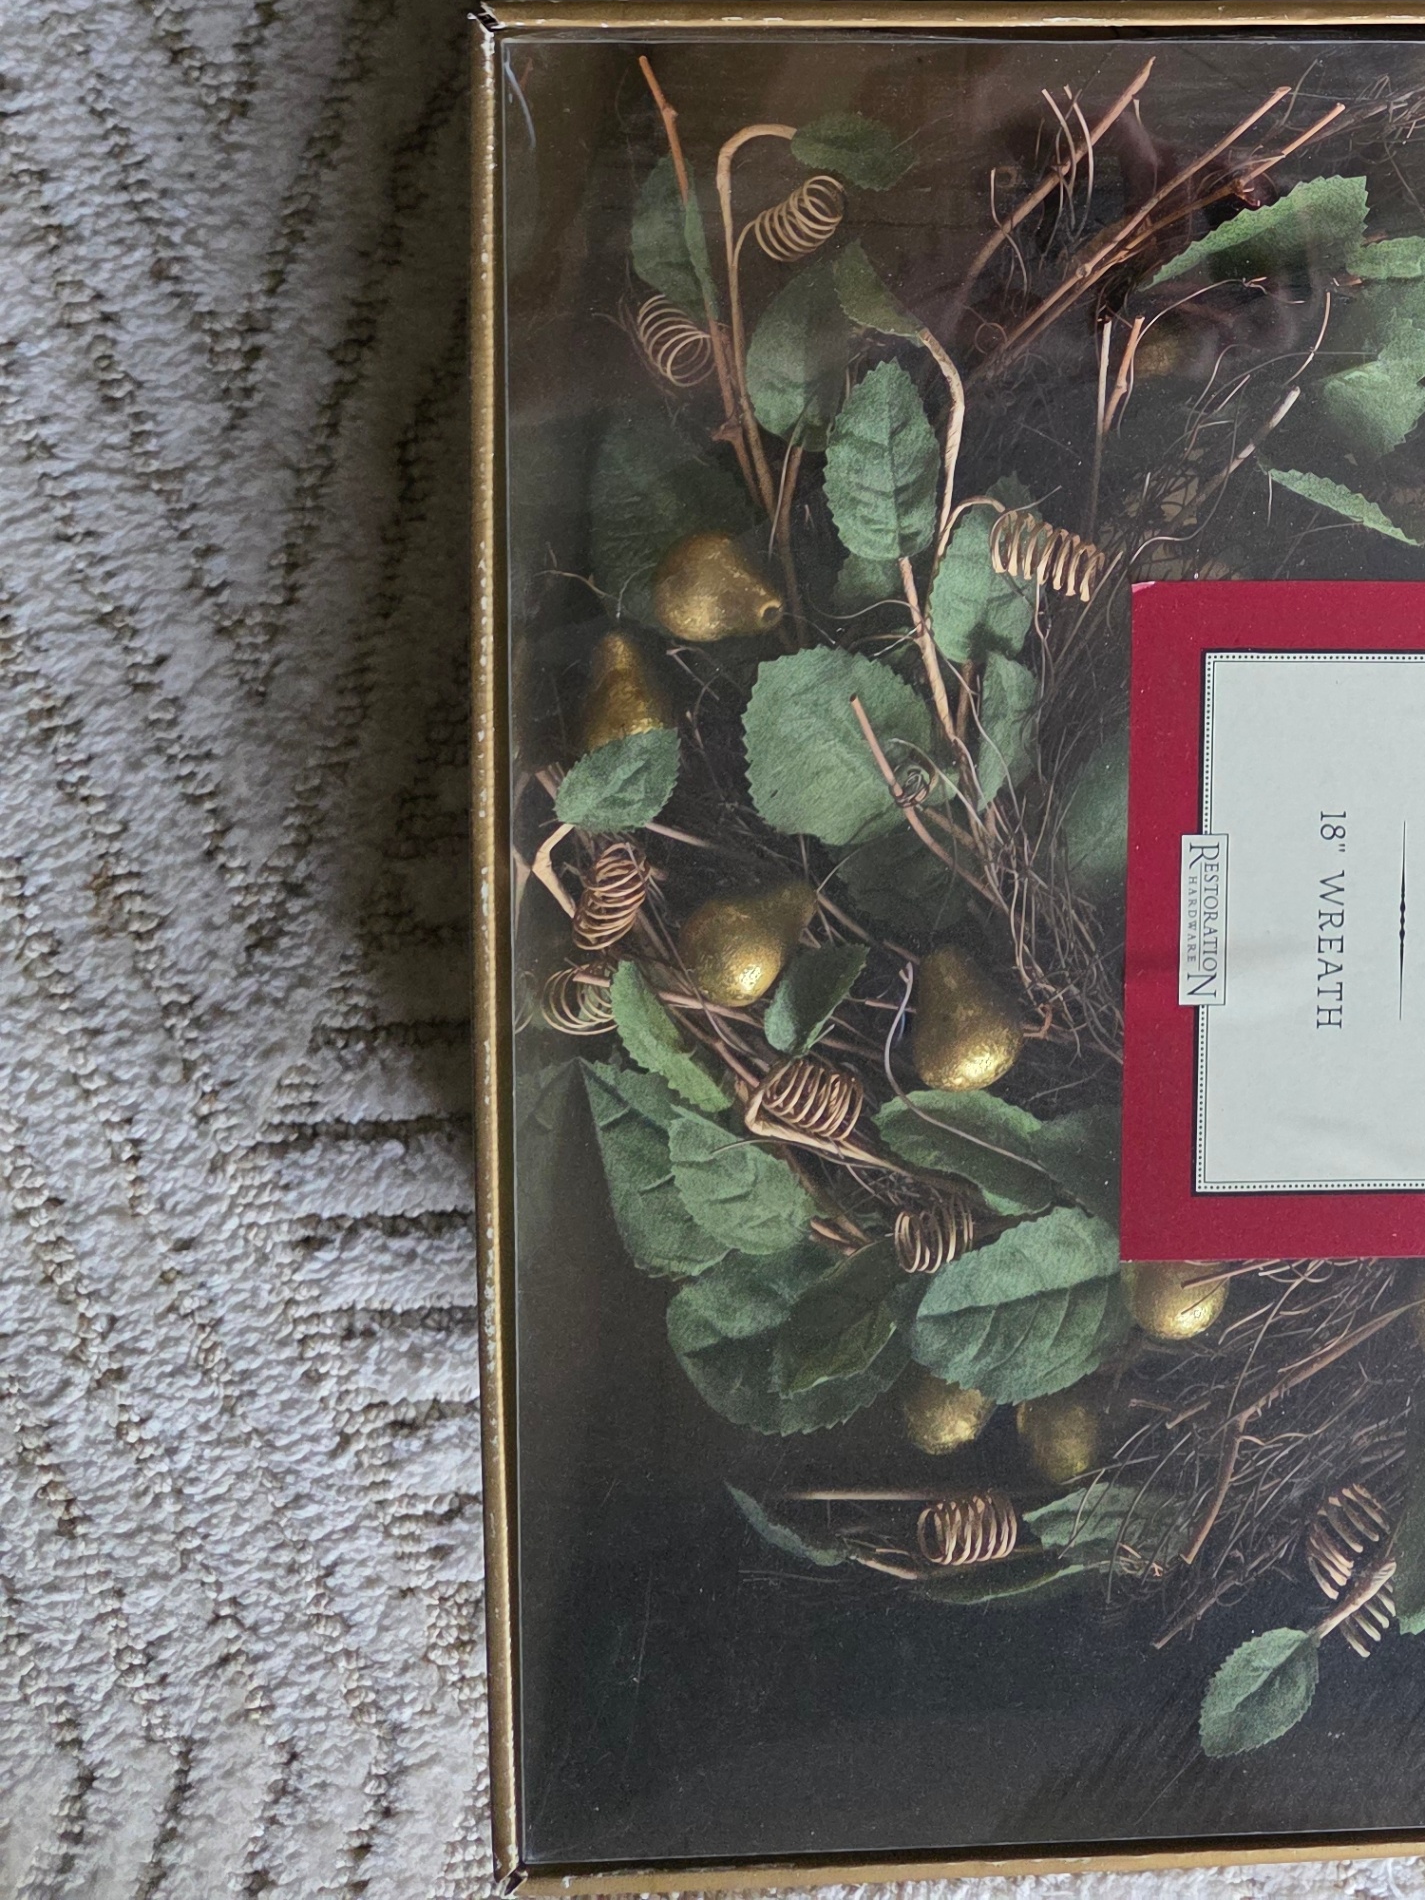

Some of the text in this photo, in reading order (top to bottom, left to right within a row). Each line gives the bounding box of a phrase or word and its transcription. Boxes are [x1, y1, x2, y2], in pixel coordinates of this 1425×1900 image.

[1187, 842, 1222, 998] RESTORATION
[1187, 876, 1200, 965] HARDWARE
[1317, 811, 1346, 1029] 18" WREATH
